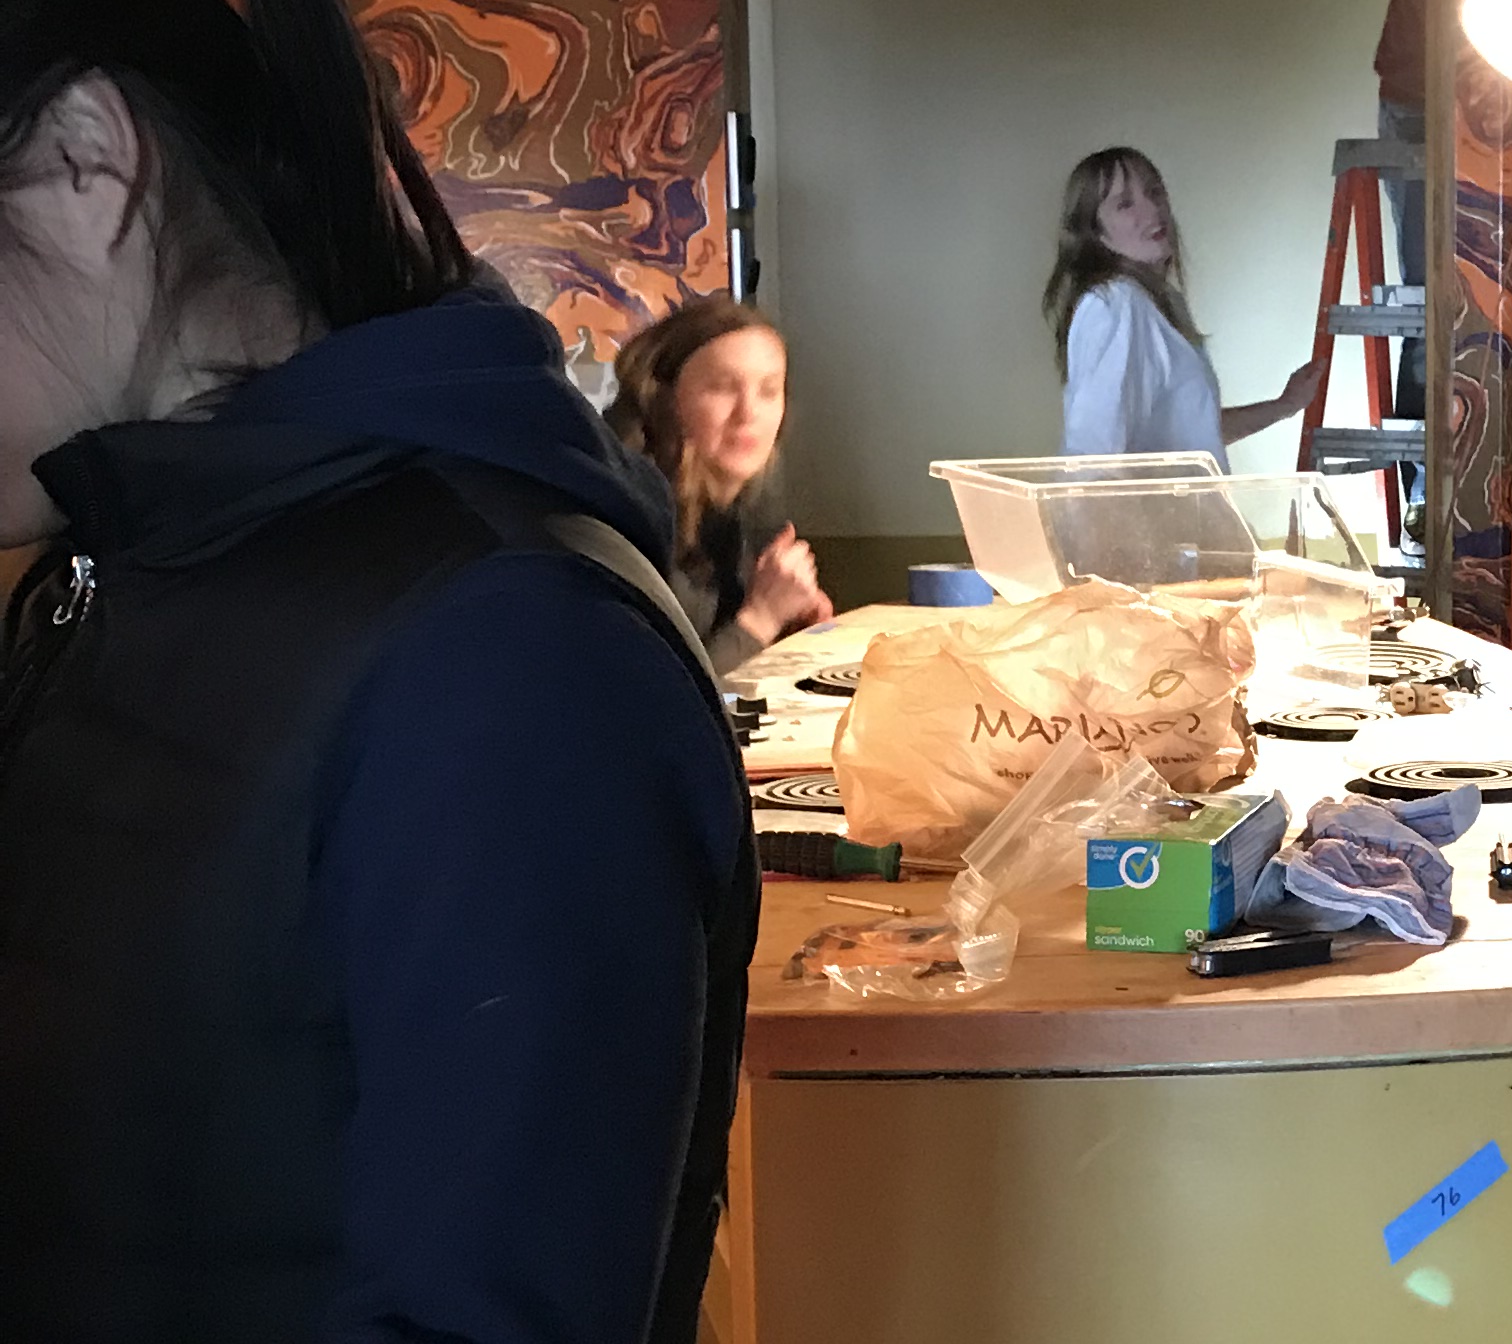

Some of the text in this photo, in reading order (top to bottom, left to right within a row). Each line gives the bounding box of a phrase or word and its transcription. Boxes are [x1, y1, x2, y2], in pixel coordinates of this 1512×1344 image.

[1094, 934, 1155, 947] sandwich
[1184, 928, 1206, 943] 90
[1431, 1186, 1462, 1217] 76
